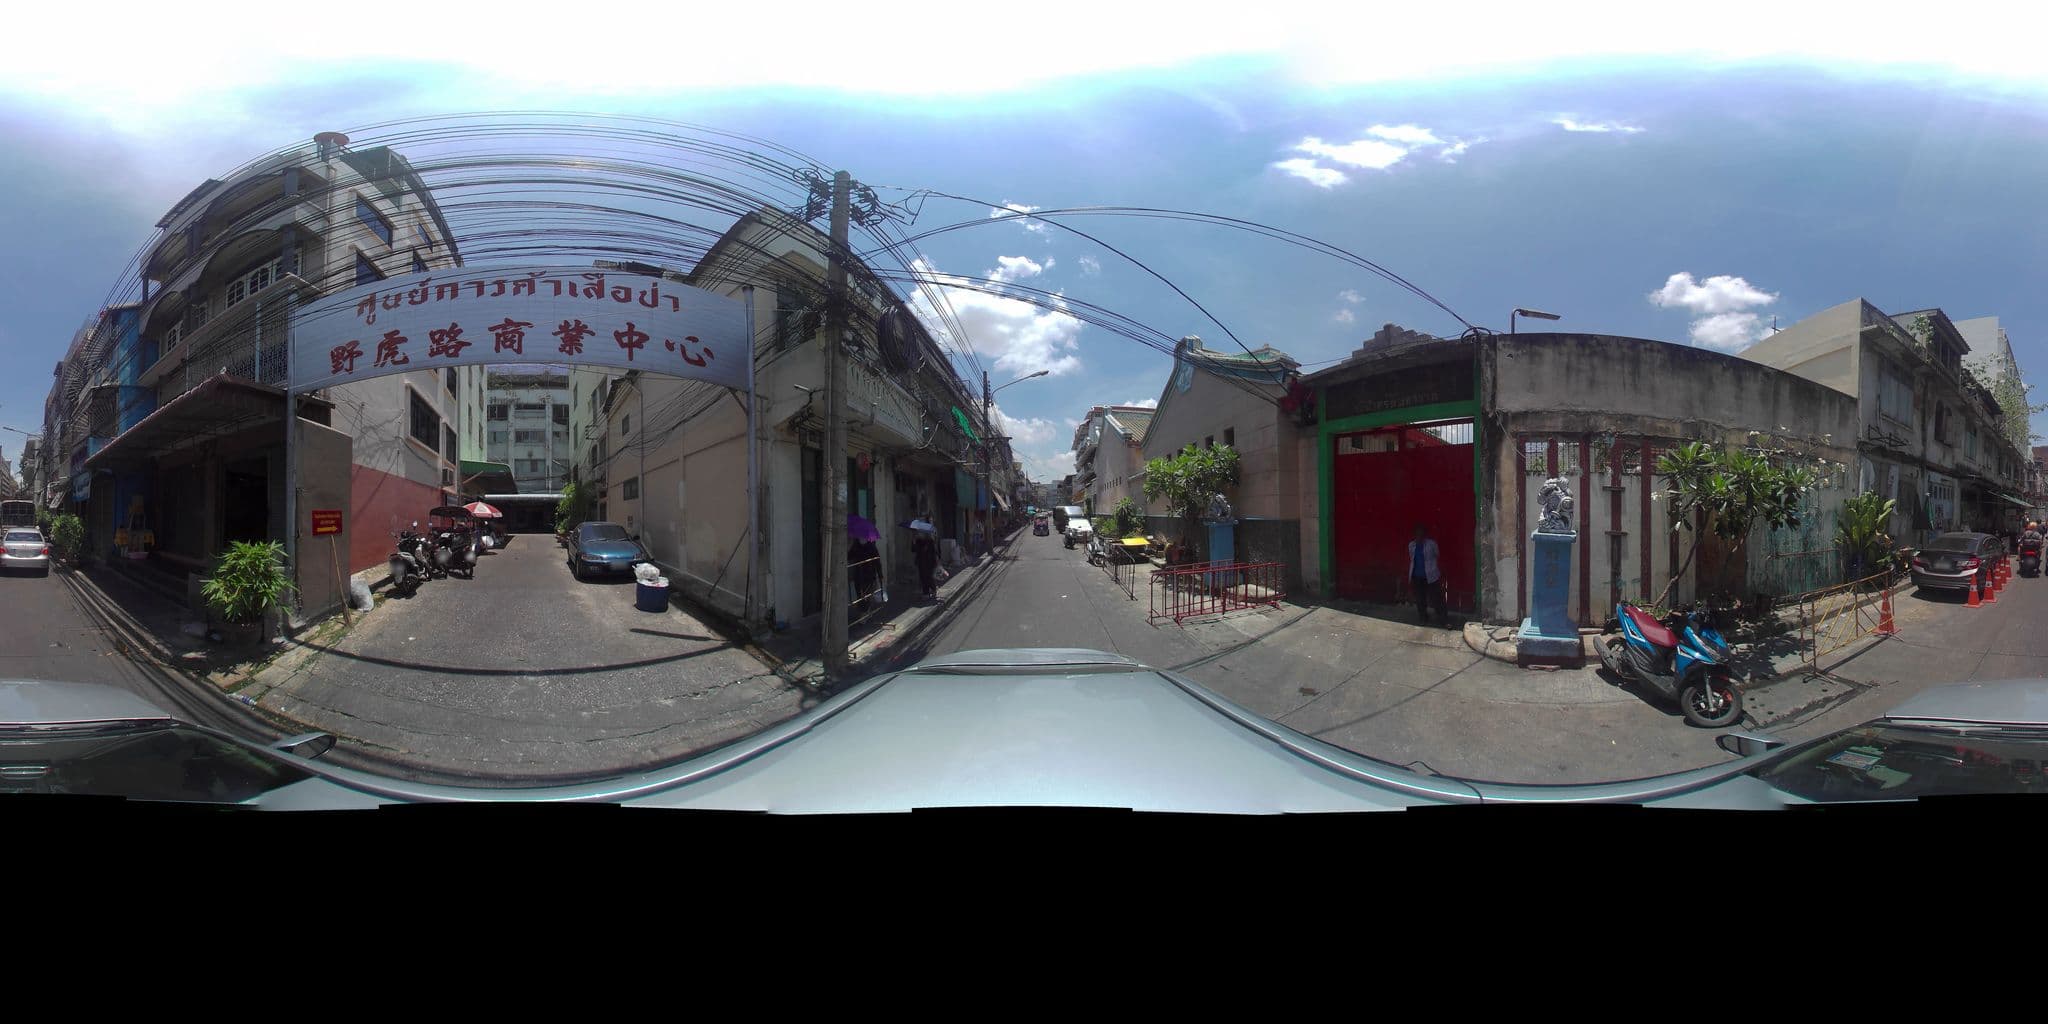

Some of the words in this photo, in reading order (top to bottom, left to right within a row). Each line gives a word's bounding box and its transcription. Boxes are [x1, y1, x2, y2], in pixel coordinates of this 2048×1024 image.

[356, 270, 680, 326] ศูนย์การค้าเสือป่า
[329, 317, 715, 375] 野虎路商業中心
